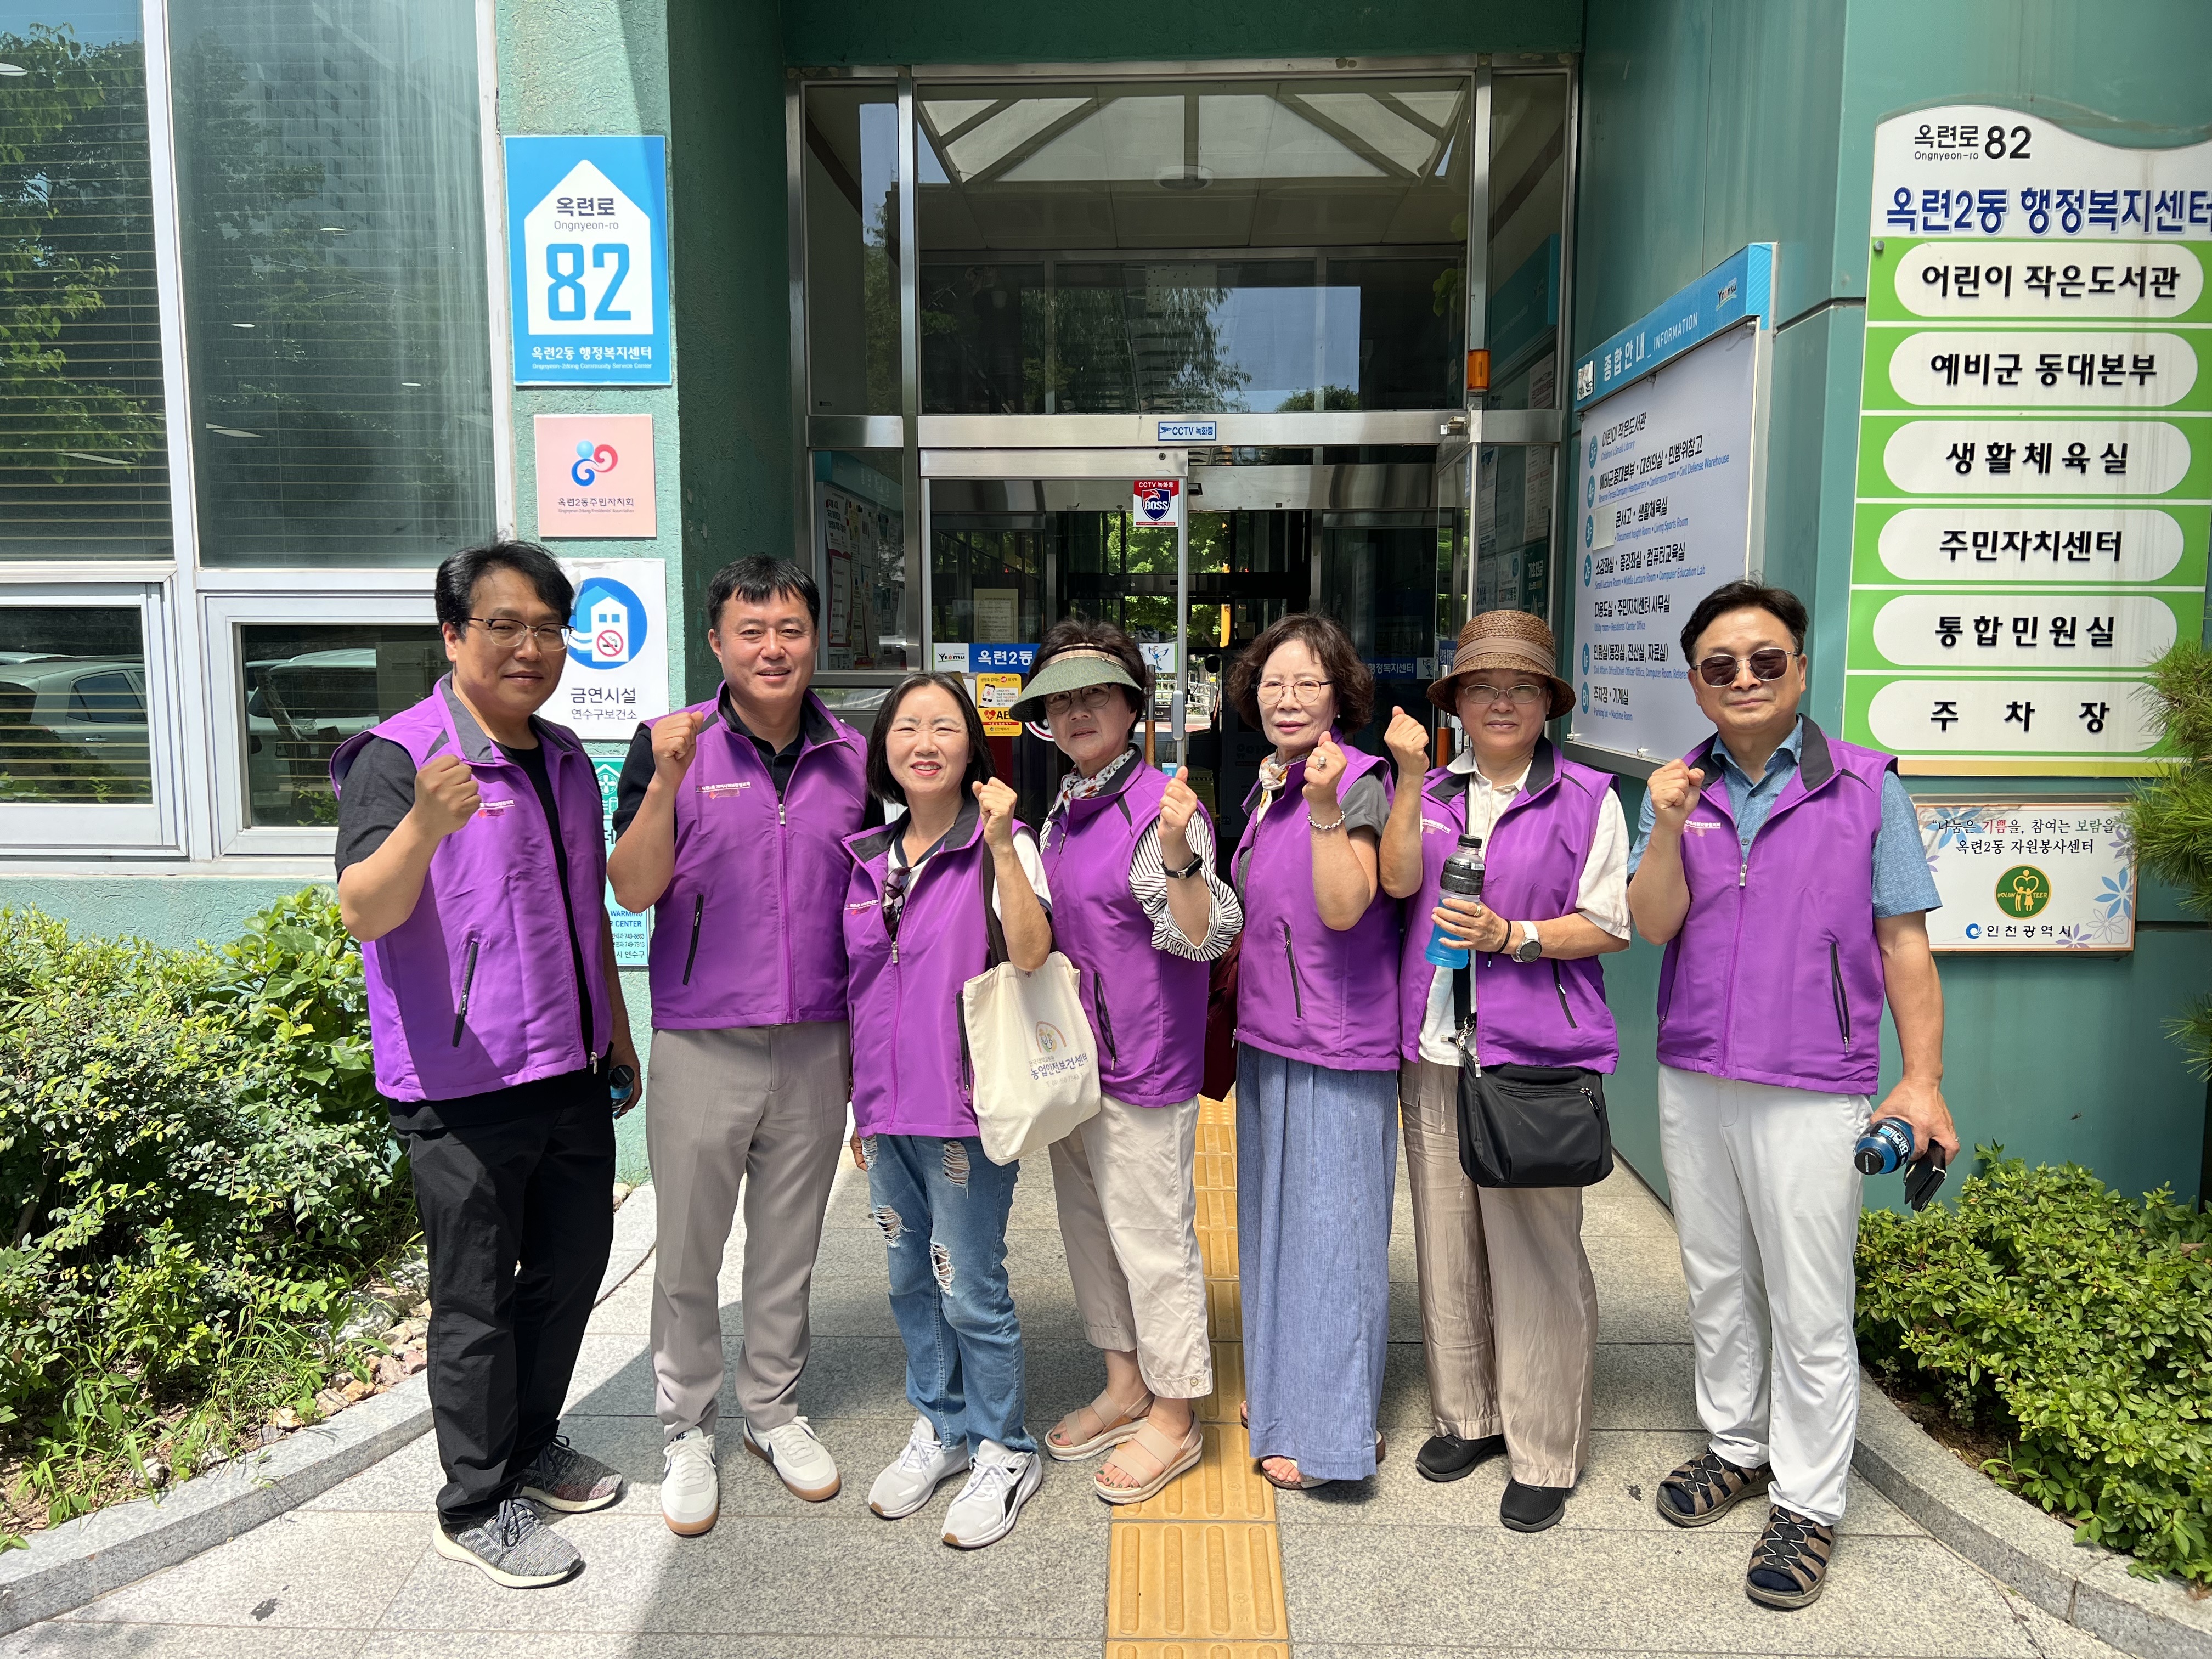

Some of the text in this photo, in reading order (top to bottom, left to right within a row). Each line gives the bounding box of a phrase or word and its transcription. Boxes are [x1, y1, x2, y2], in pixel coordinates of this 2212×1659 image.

[1914, 125, 2032, 160] 옥련로 82
[1914, 151, 1979, 161] Ongnyeon-ro
[556, 197, 616, 217] 옥련로
[1887, 187, 2212, 234] 옥련2동 행정복지센터
[554, 220, 619, 232] Ongnyeon-ro
[546, 243, 631, 321] 82
[1922, 265, 2181, 299] 어린이 작은도서관
[1653, 311, 1698, 352] INFORMATION
[531, 346, 652, 360] 옥련2동 행정복지센터
[1604, 332, 1645, 382] 종합안내
[1931, 353, 2158, 386] 예비군 동대본부
[1172, 426, 1214, 436] CCTV 녹화중
[1602, 411, 1646, 447] 어린이 작은도서관
[1640, 449, 1664, 476] 대회의실
[1668, 434, 1703, 466] 민방위창고
[1945, 442, 2129, 475] 생활체육실
[1649, 474, 1667, 487] Conference
[1688, 461, 1703, 475] Defense
[1704, 454, 1730, 470] Warehouse
[557, 498, 634, 507] 옥련2동주민자치회
[1144, 501, 1168, 510] BOSS
[1616, 496, 1668, 528] 문서고 생활체육실
[1654, 522, 1664, 534] Living
[1664, 520, 1677, 531] Sports
[1677, 517, 1689, 527] Room
[1939, 531, 2123, 562] 주민자치센터
[1595, 542, 1685, 575] 소강좌실 중강좌실 컴퓨터교육실
[1646, 573, 1656, 582] Room
[1659, 569, 1677, 582] Computer
[1677, 566, 1697, 578] Education
[1697, 565, 1706, 575] Lab
[1594, 594, 1671, 618] 다용도실 주민자치센터 사무실
[1935, 616, 2115, 648] 통합민원실
[938, 653, 965, 662] Yeonsu
[978, 650, 1033, 666] 옥련2동
[1648, 643, 1669, 662] 자료실)
[1368, 663, 1414, 674] 행정복지센터
[1646, 668, 1661, 679] Computer
[1673, 669, 1688, 679] Referen
[571, 687, 637, 704] 금연시설
[1594, 686, 1629, 706] 주차장 기계실
[571, 709, 637, 720] 연수구보건소
[996, 711, 1009, 720] AE
[1982, 819, 2025, 834] 기쁨을,
[2031, 819, 2071, 834] 참여는
[1956, 838, 2094, 854] 옥련2동 자원봉사센터
[1987, 924, 2072, 938] 인천광역시
[1031, 1052, 1088, 1080] 농업안전보건센터
